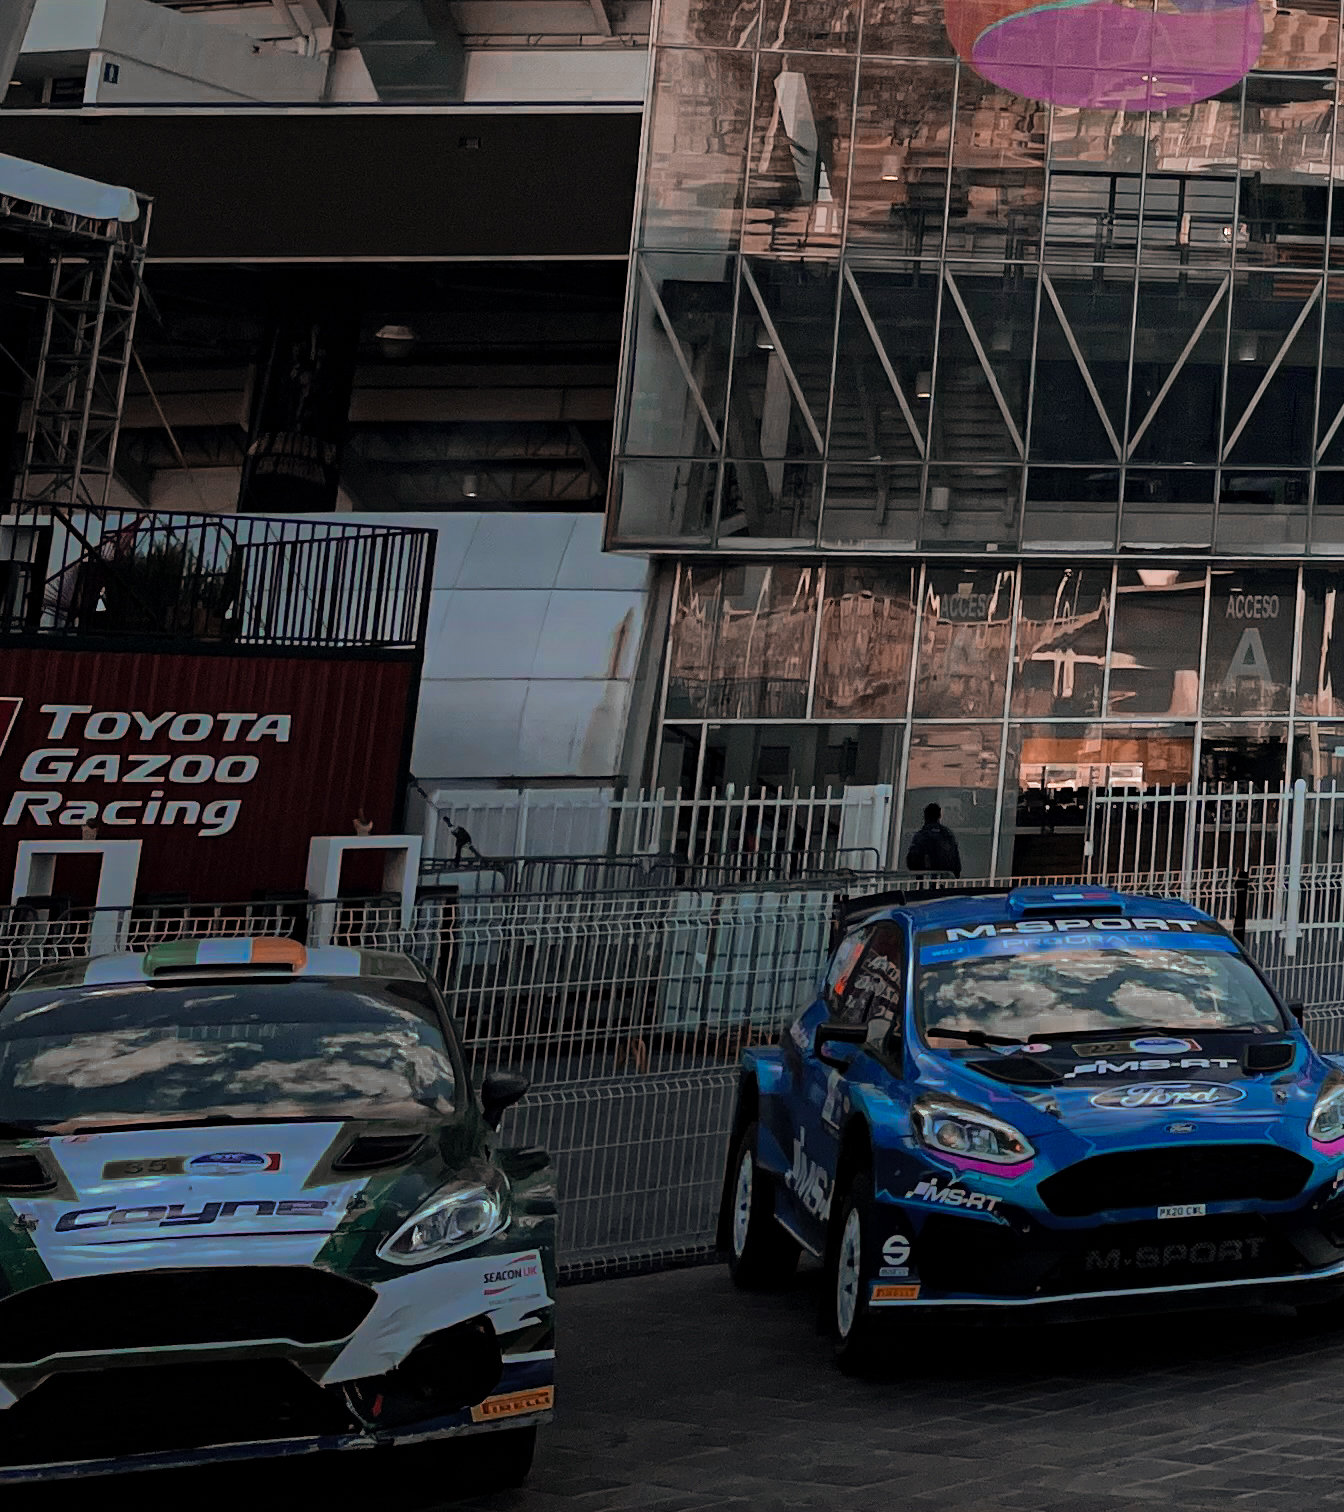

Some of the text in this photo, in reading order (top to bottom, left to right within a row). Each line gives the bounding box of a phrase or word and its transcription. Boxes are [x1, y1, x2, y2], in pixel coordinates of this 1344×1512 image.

[940, 593, 996, 619] ACCES
[1225, 594, 1280, 619] ACCESO
[1222, 626, 1273, 688] A
[40, 704, 291, 743] TOYOTA
[20, 748, 260, 784] GAZOO
[3, 791, 242, 837] Racing
[945, 918, 1198, 942] M-SPORT
[1091, 1044, 1120, 1054] 22
[1119, 1084, 1221, 1108] Ford
[124, 1161, 168, 1175] 35
[1085, 1236, 1267, 1271] M-SPORT
[484, 1268, 522, 1284] SEACON
